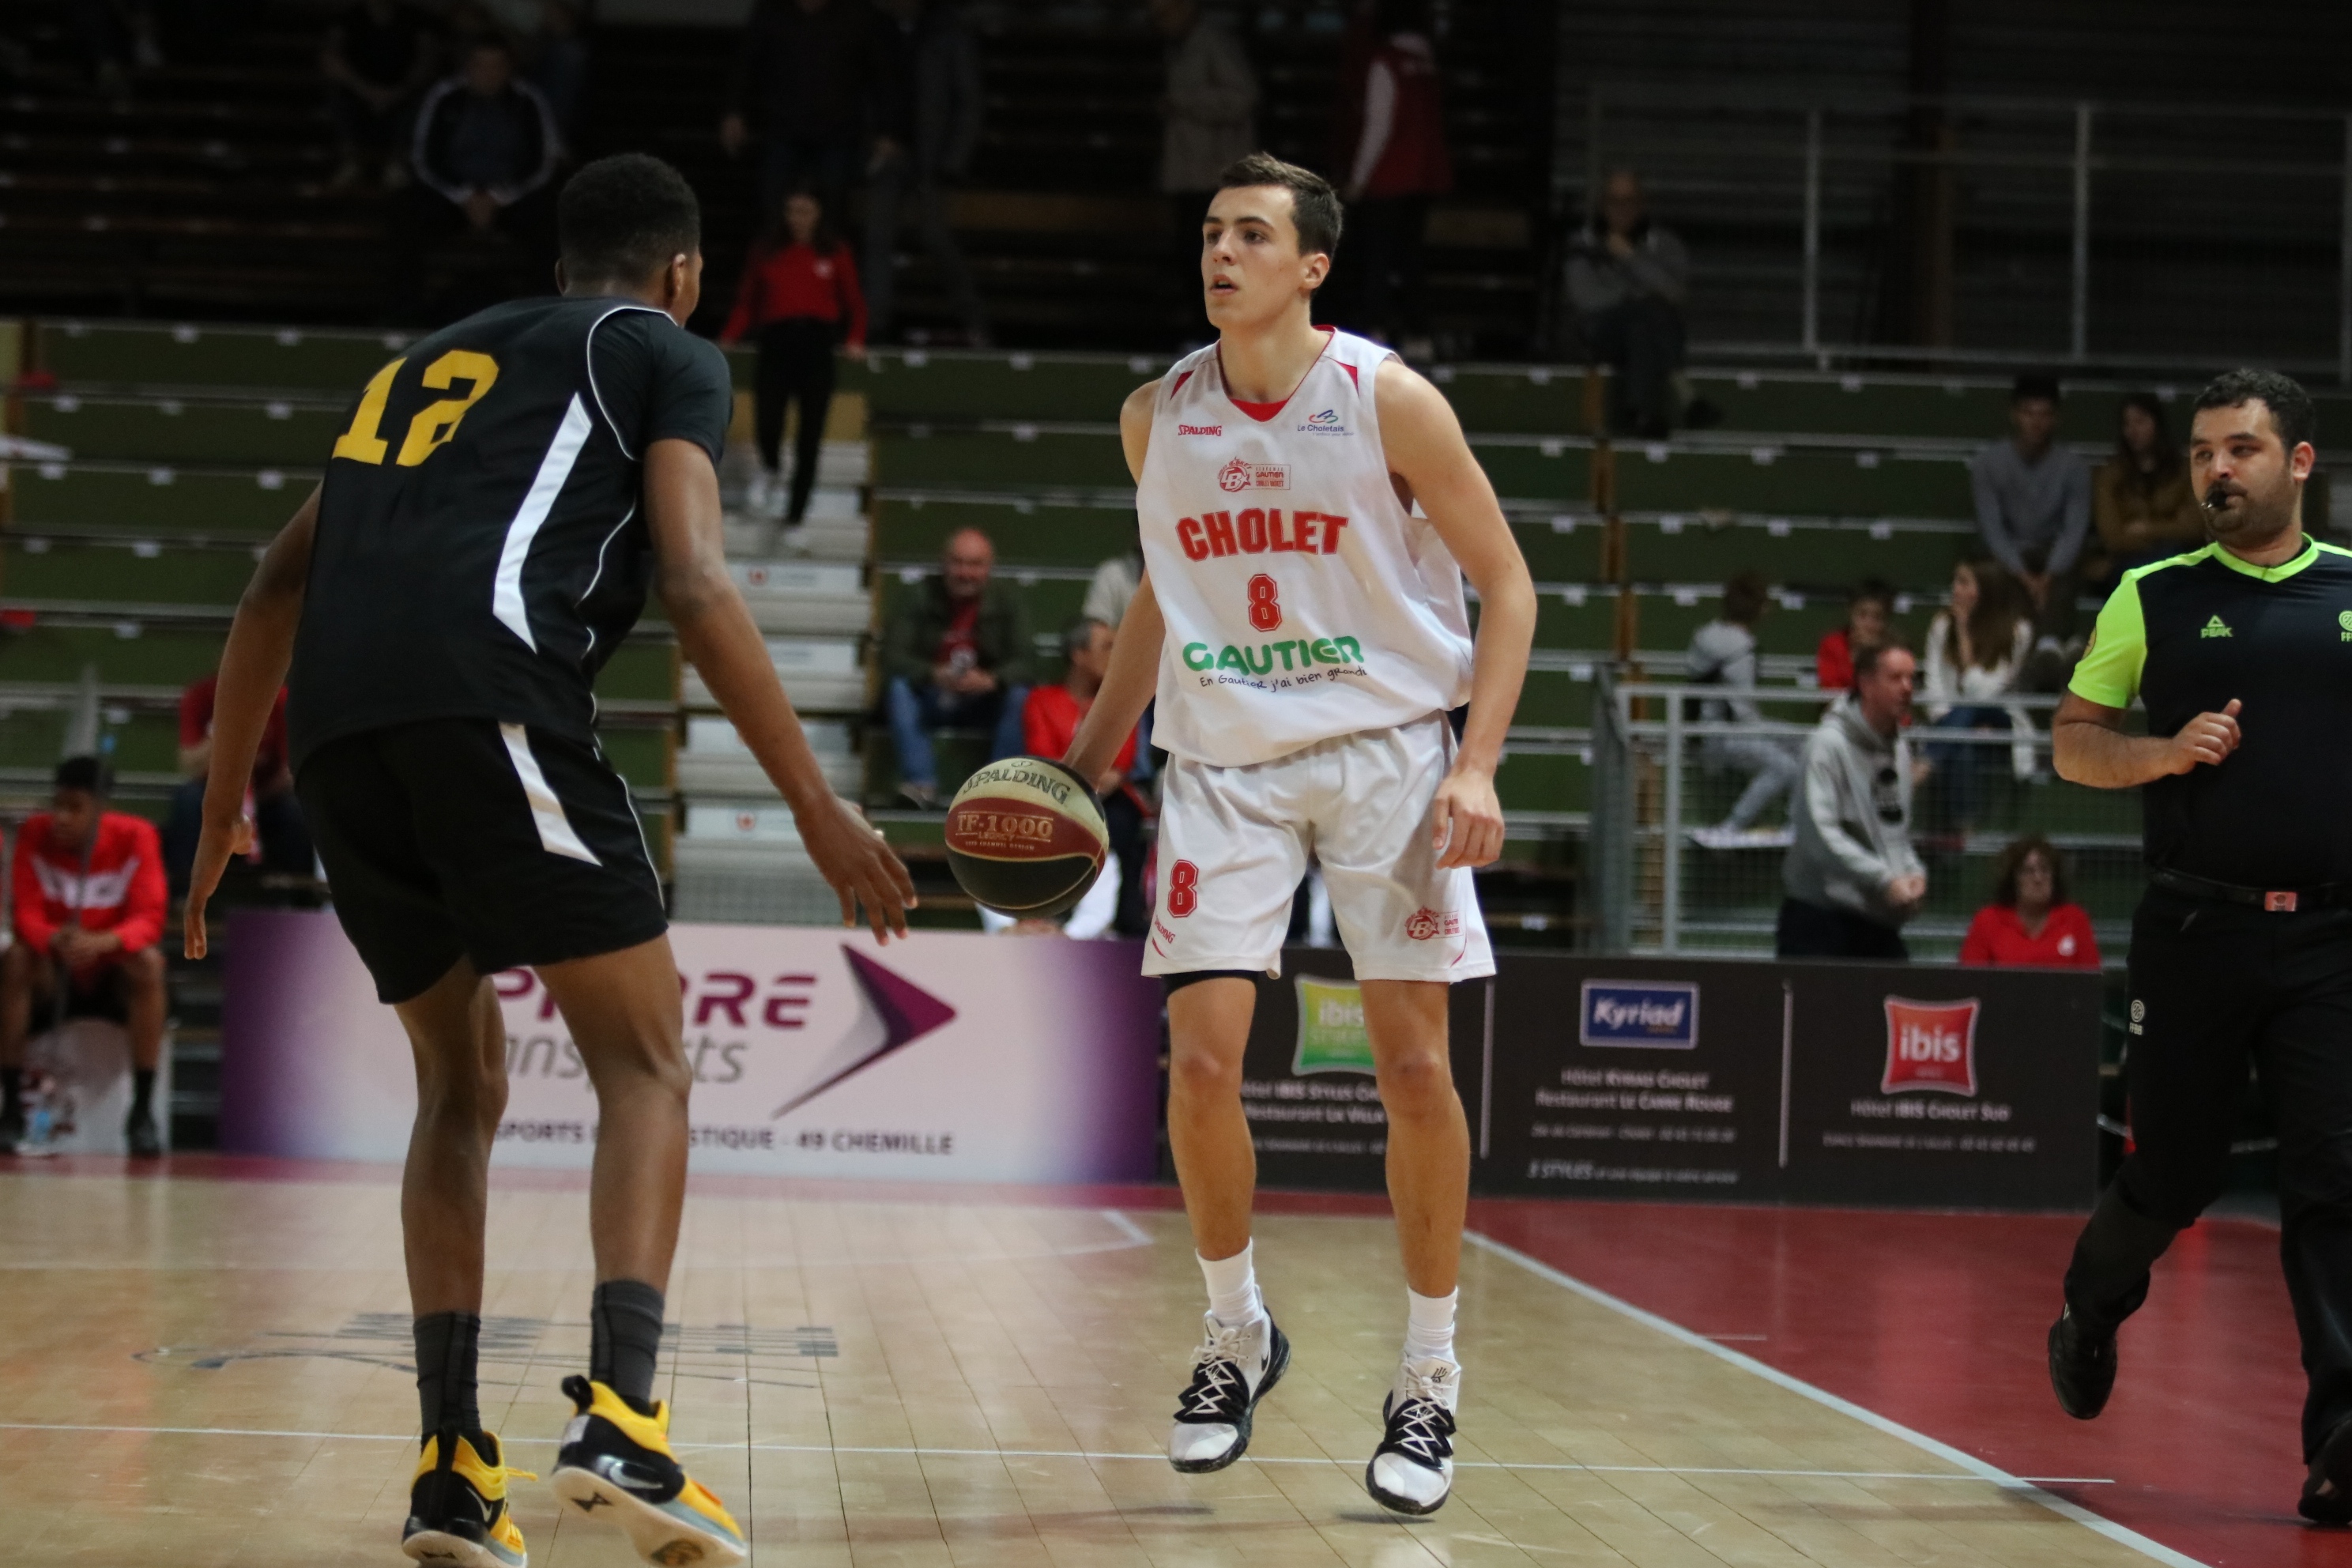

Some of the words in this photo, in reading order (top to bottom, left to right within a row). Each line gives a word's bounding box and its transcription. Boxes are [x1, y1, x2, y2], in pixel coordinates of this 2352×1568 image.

[332, 349, 499, 466] 12
[1178, 424, 1222, 436] SPALDING
[1175, 508, 1348, 562] CHOLET
[1247, 573, 1283, 632] 8
[2200, 627, 2233, 639] PEAK
[1182, 635, 1365, 676] GAUTIER
[1200, 677, 1214, 688] En
[1270, 677, 1292, 693] j'ai
[1296, 672, 1322, 686] bien
[962, 768, 1072, 805] SPALDING
[956, 813, 1054, 838] TF-1000
[1167, 859, 1199, 918] 8
[1593, 997, 1686, 1031] Kyriad
[1899, 1023, 1962, 1062] ibis
[1894, 1099, 1925, 1118] IBIS
